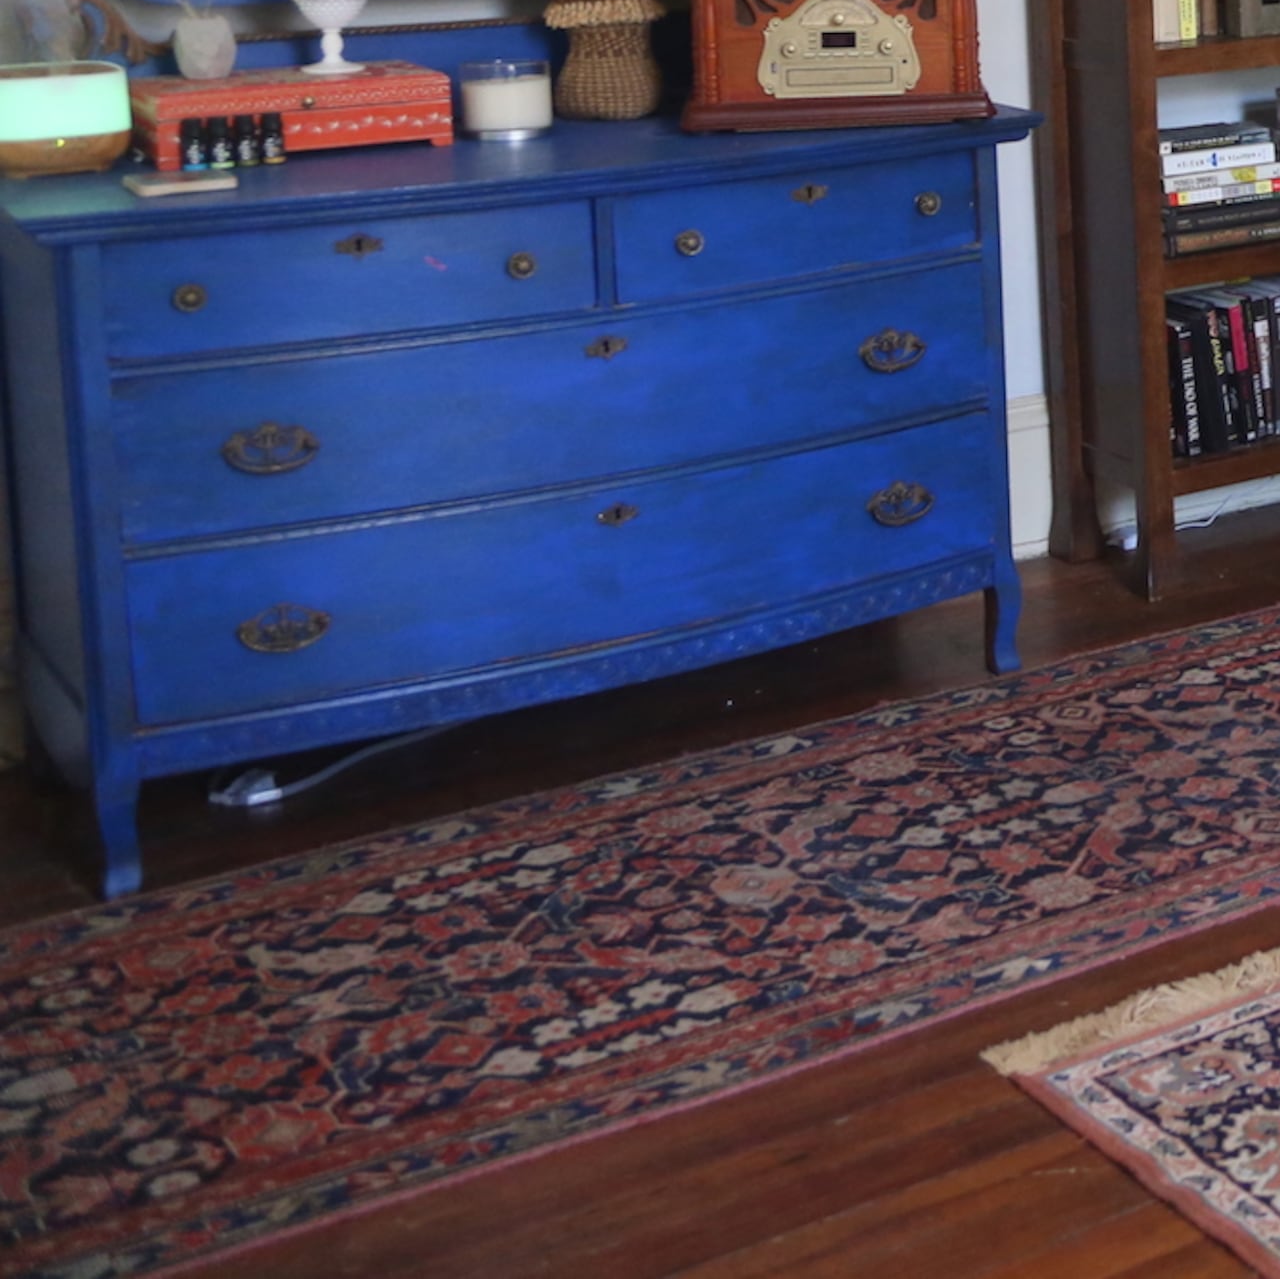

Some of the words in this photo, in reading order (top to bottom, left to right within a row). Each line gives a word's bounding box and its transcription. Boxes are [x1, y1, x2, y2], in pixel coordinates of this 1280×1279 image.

[1181, 357, 1194, 379] THE
[1183, 381, 1196, 401] TAO
[1185, 402, 1198, 417] OF
[1187, 418, 1200, 442] WAR
